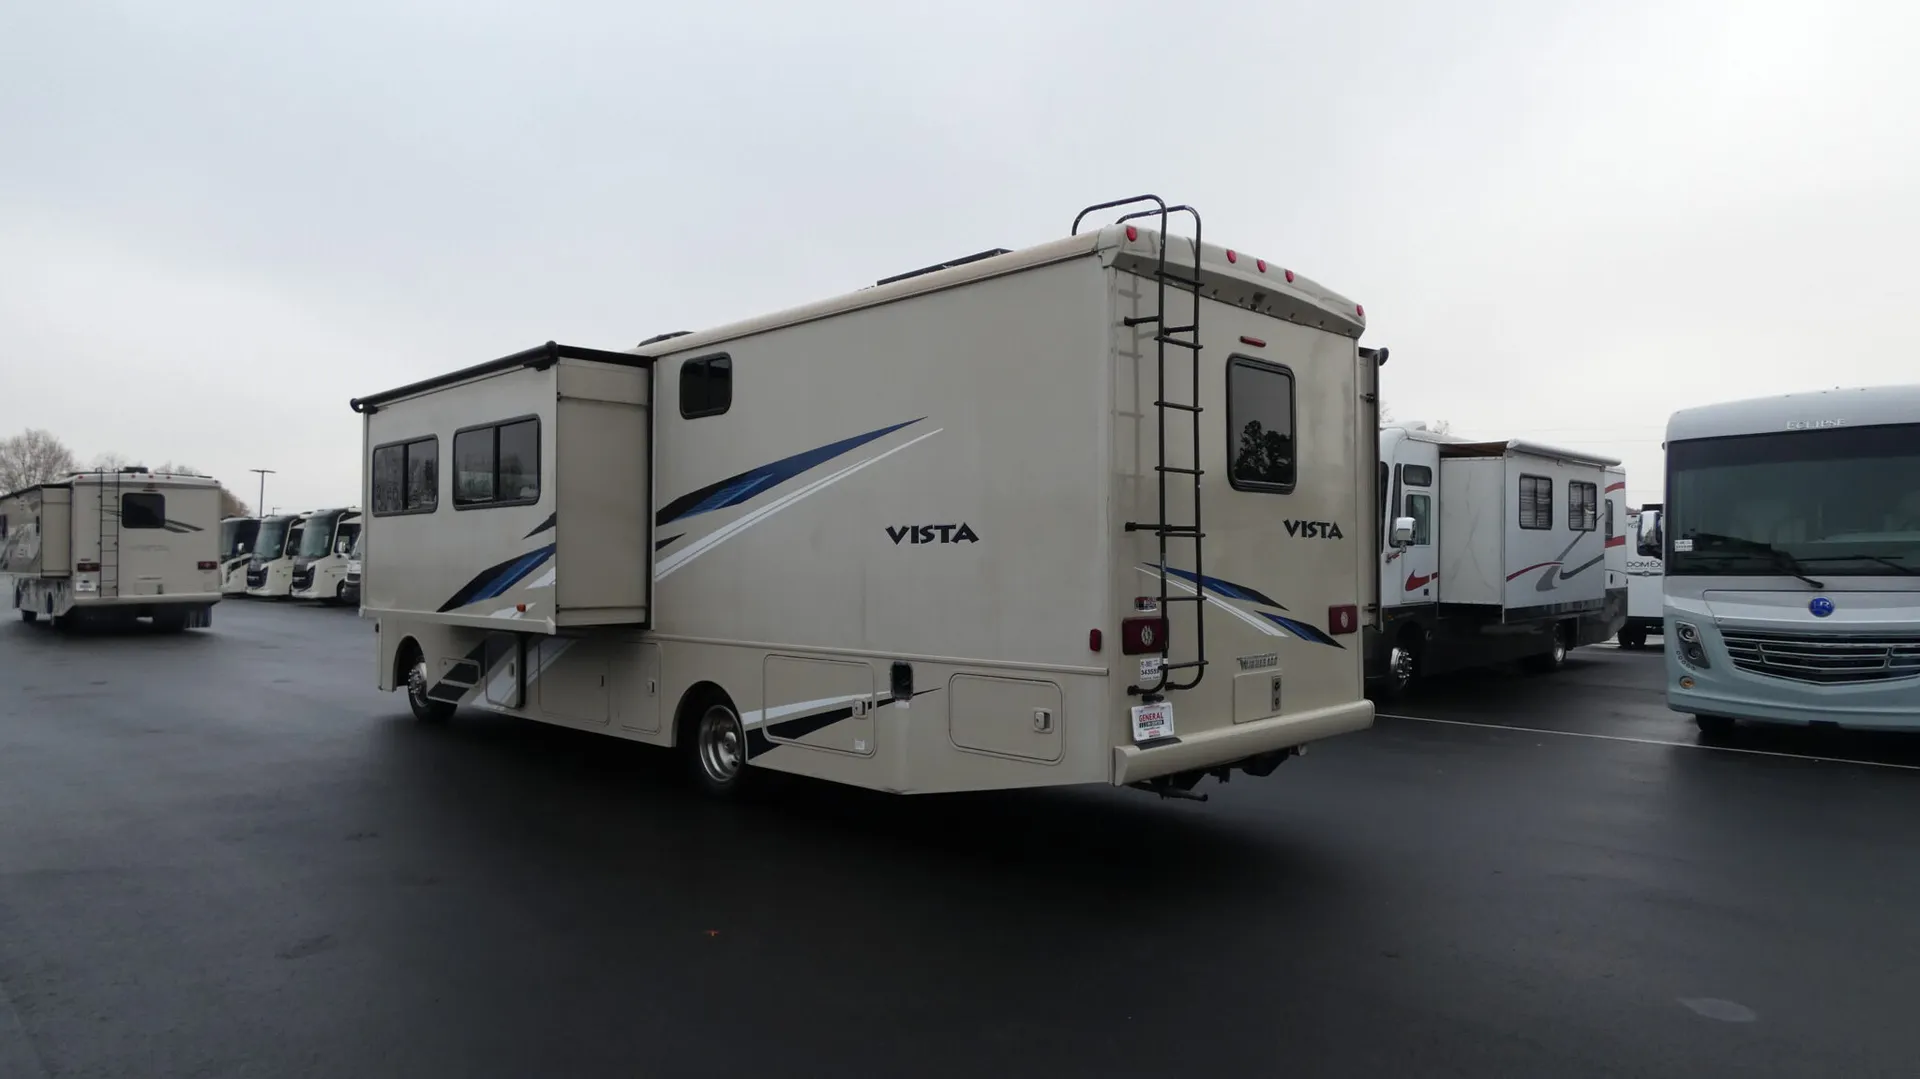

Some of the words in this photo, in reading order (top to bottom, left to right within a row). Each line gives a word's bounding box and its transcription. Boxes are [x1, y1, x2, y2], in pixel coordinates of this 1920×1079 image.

[1786, 418, 1846, 430] ECLIPSE
[885, 522, 980, 546] VISTA
[1283, 519, 1344, 540] VISTA
[1138, 711, 1164, 723] GENERAL
